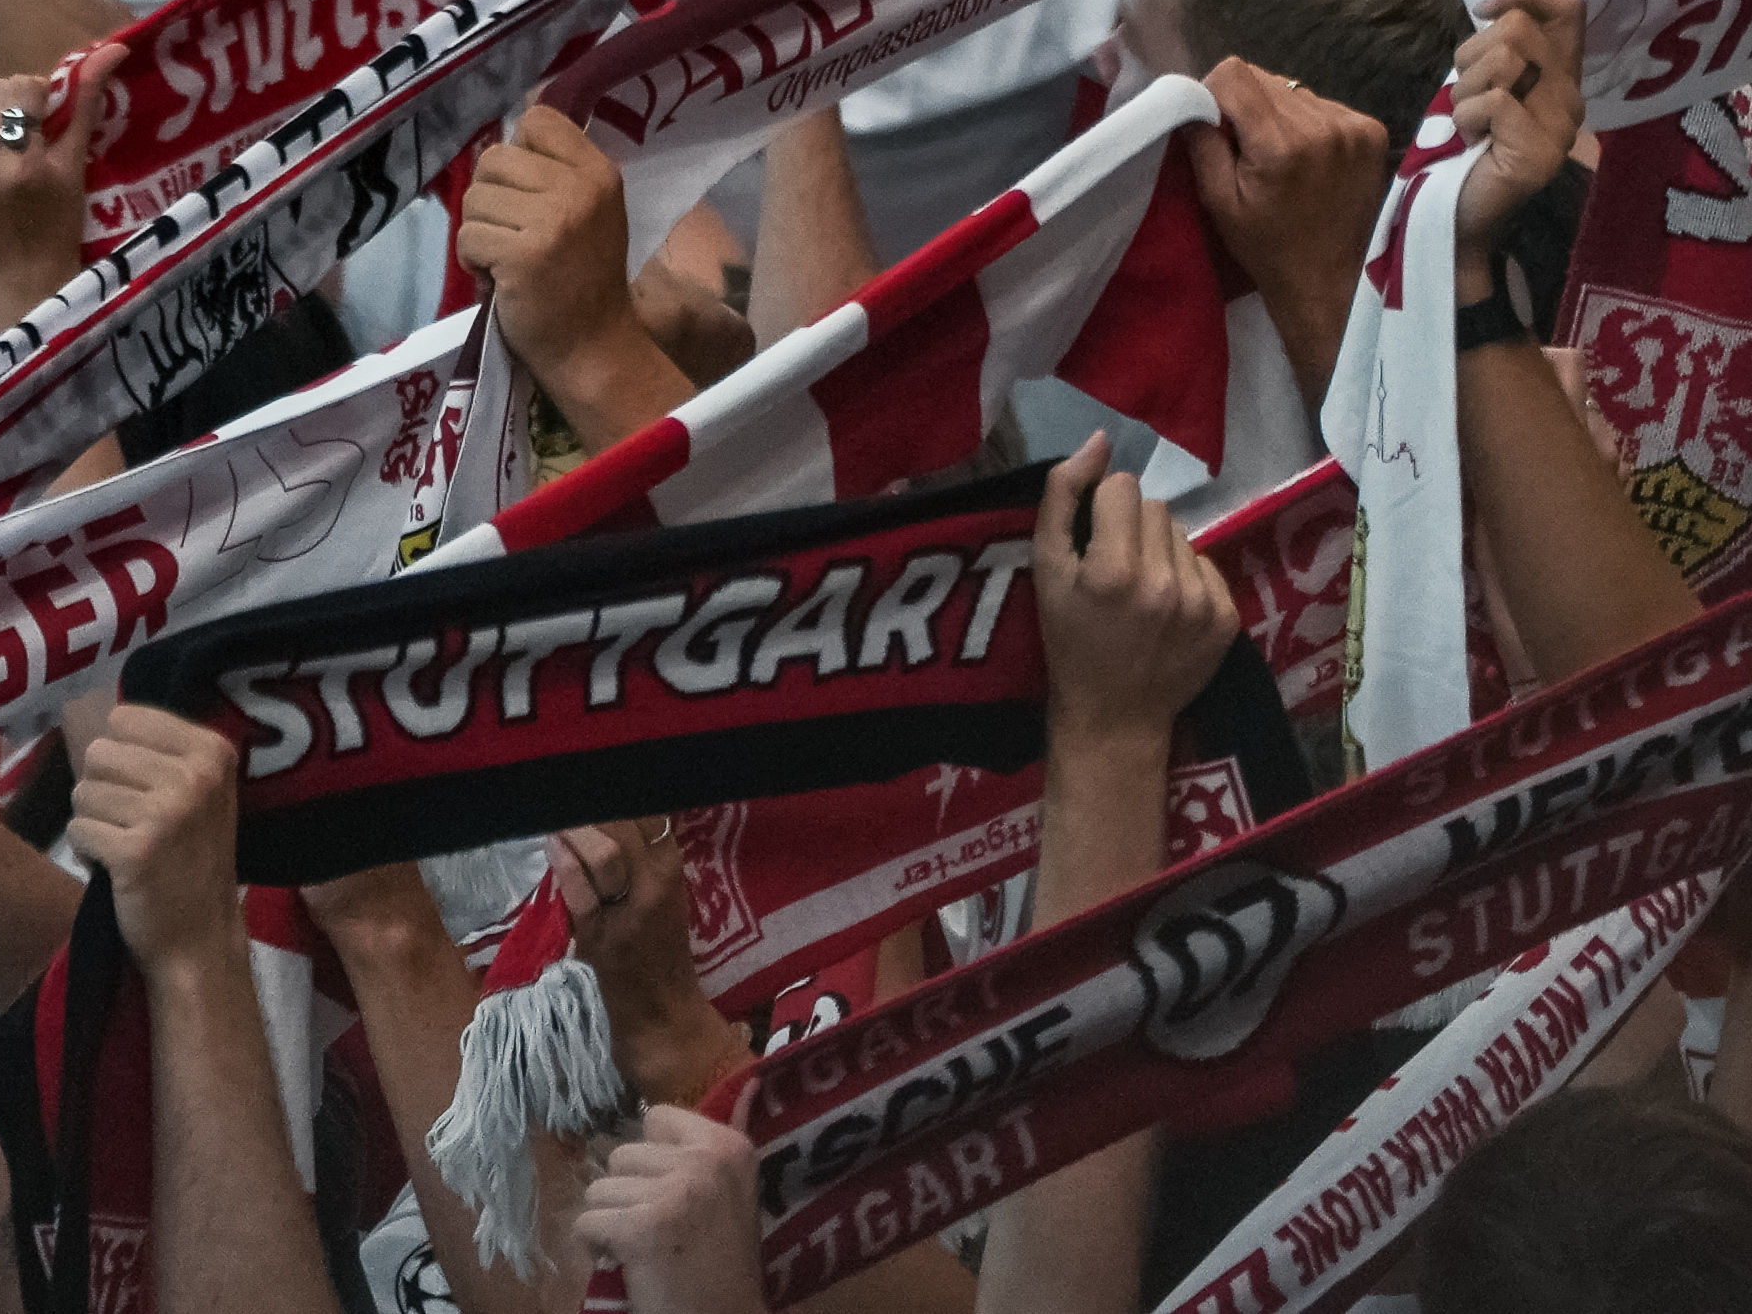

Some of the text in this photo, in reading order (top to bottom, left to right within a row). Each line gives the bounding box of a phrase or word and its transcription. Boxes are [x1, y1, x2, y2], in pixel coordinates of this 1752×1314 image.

[240, 535, 1038, 782] STUTTGART
[1474, 968, 1595, 1124] NEVER
[1387, 1068, 1480, 1214] WALK
[1277, 1154, 1398, 1284] ALONE
